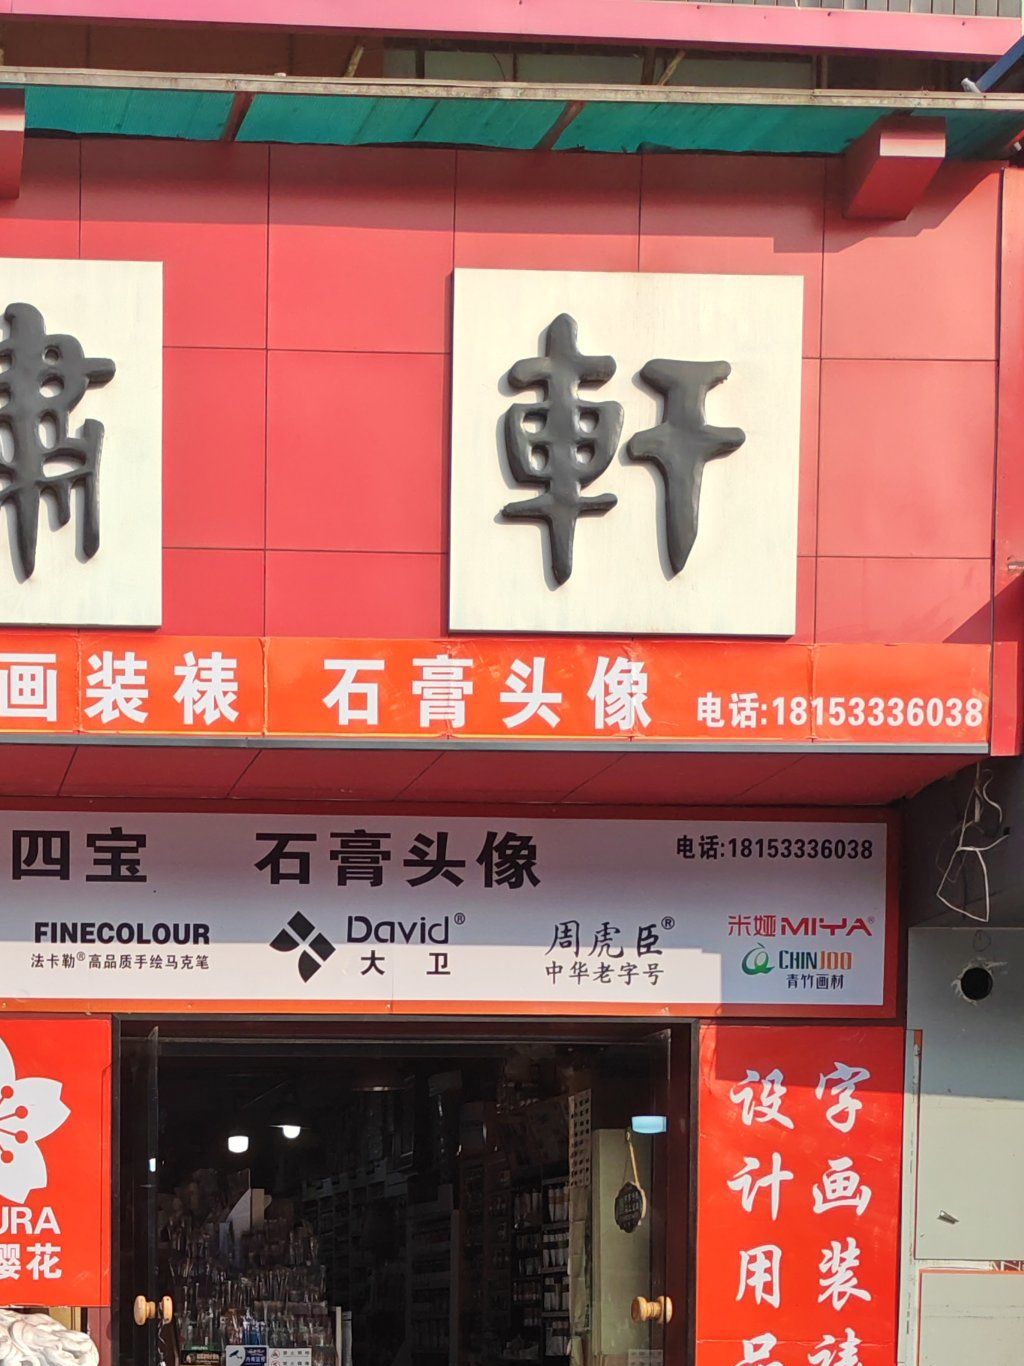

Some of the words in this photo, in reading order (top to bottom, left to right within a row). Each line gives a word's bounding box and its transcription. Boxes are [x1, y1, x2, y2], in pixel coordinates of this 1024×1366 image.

[323, 654, 650, 730] 石膏头像
[697, 691, 983, 728] 电话:18153336038
[254, 828, 542, 889] 石膏头像
[676, 835, 873, 860] 电话:18153336038
[34, 922, 210, 945] FINECOLOUR
[347, 915, 449, 944] David
[545, 920, 663, 958] 周虎臣
[781, 917, 872, 936] MIYA
[779, 950, 852, 970] CHINJOO
[545, 961, 664, 986] 中华老字号
[786, 973, 844, 990] 青竹画材
